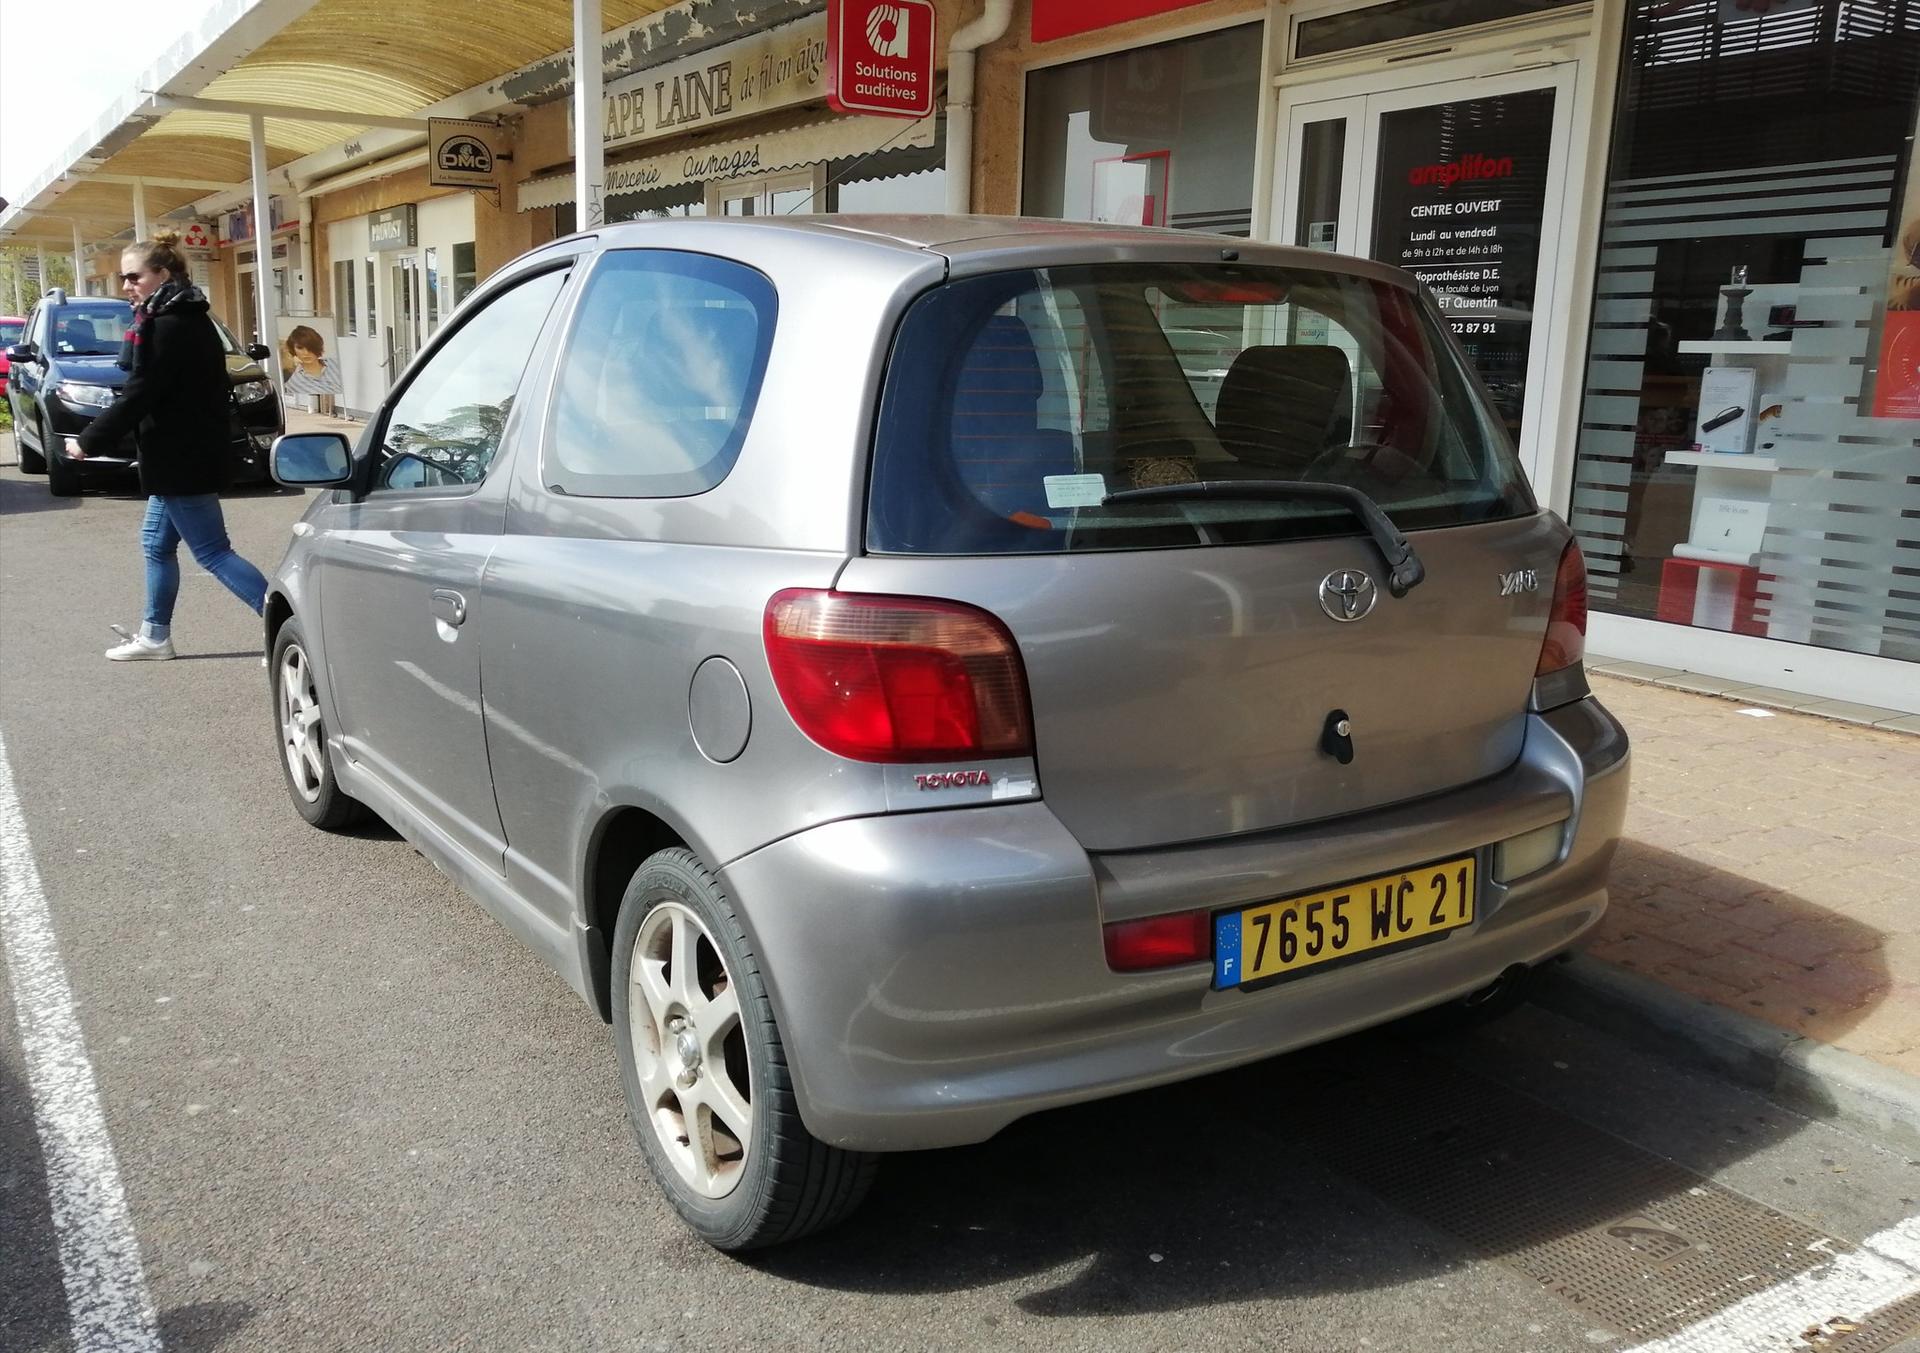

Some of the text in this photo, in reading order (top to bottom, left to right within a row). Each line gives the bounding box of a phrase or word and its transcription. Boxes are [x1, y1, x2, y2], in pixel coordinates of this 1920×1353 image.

[855, 62, 917, 82] Solutions
[603, 88, 645, 142] APE
[655, 61, 733, 129] LAINE
[741, 66, 755, 101] de
[759, 54, 773, 103] fil
[776, 57, 791, 84] en
[855, 83, 917, 101] auditives
[441, 153, 490, 171] DMC
[604, 144, 760, 191] Mercerie Ouvrages
[1408, 153, 1513, 189] amplifon
[1410, 199, 1502, 217] CENTRE OUVERT
[1410, 226, 1497, 241] Lundi au vendredi
[1402, 244, 1503, 257] de 9h à 12h et de 14h à 18h
[1482, 269, 1500, 280] D.E.
[1437, 285, 1444, 293] la
[1445, 284, 1469, 293] faculté
[1471, 284, 1480, 292] de
[1482, 284, 1499, 294] Lyon
[1453, 296, 1498, 309] Quentin
[1466, 323, 1480, 333] 87
[1482, 322, 1496, 333] 91
[913, 770, 991, 790] TOYOTA
[1252, 867, 1467, 973] 7655 WC 21
[1224, 958, 1234, 976] F
